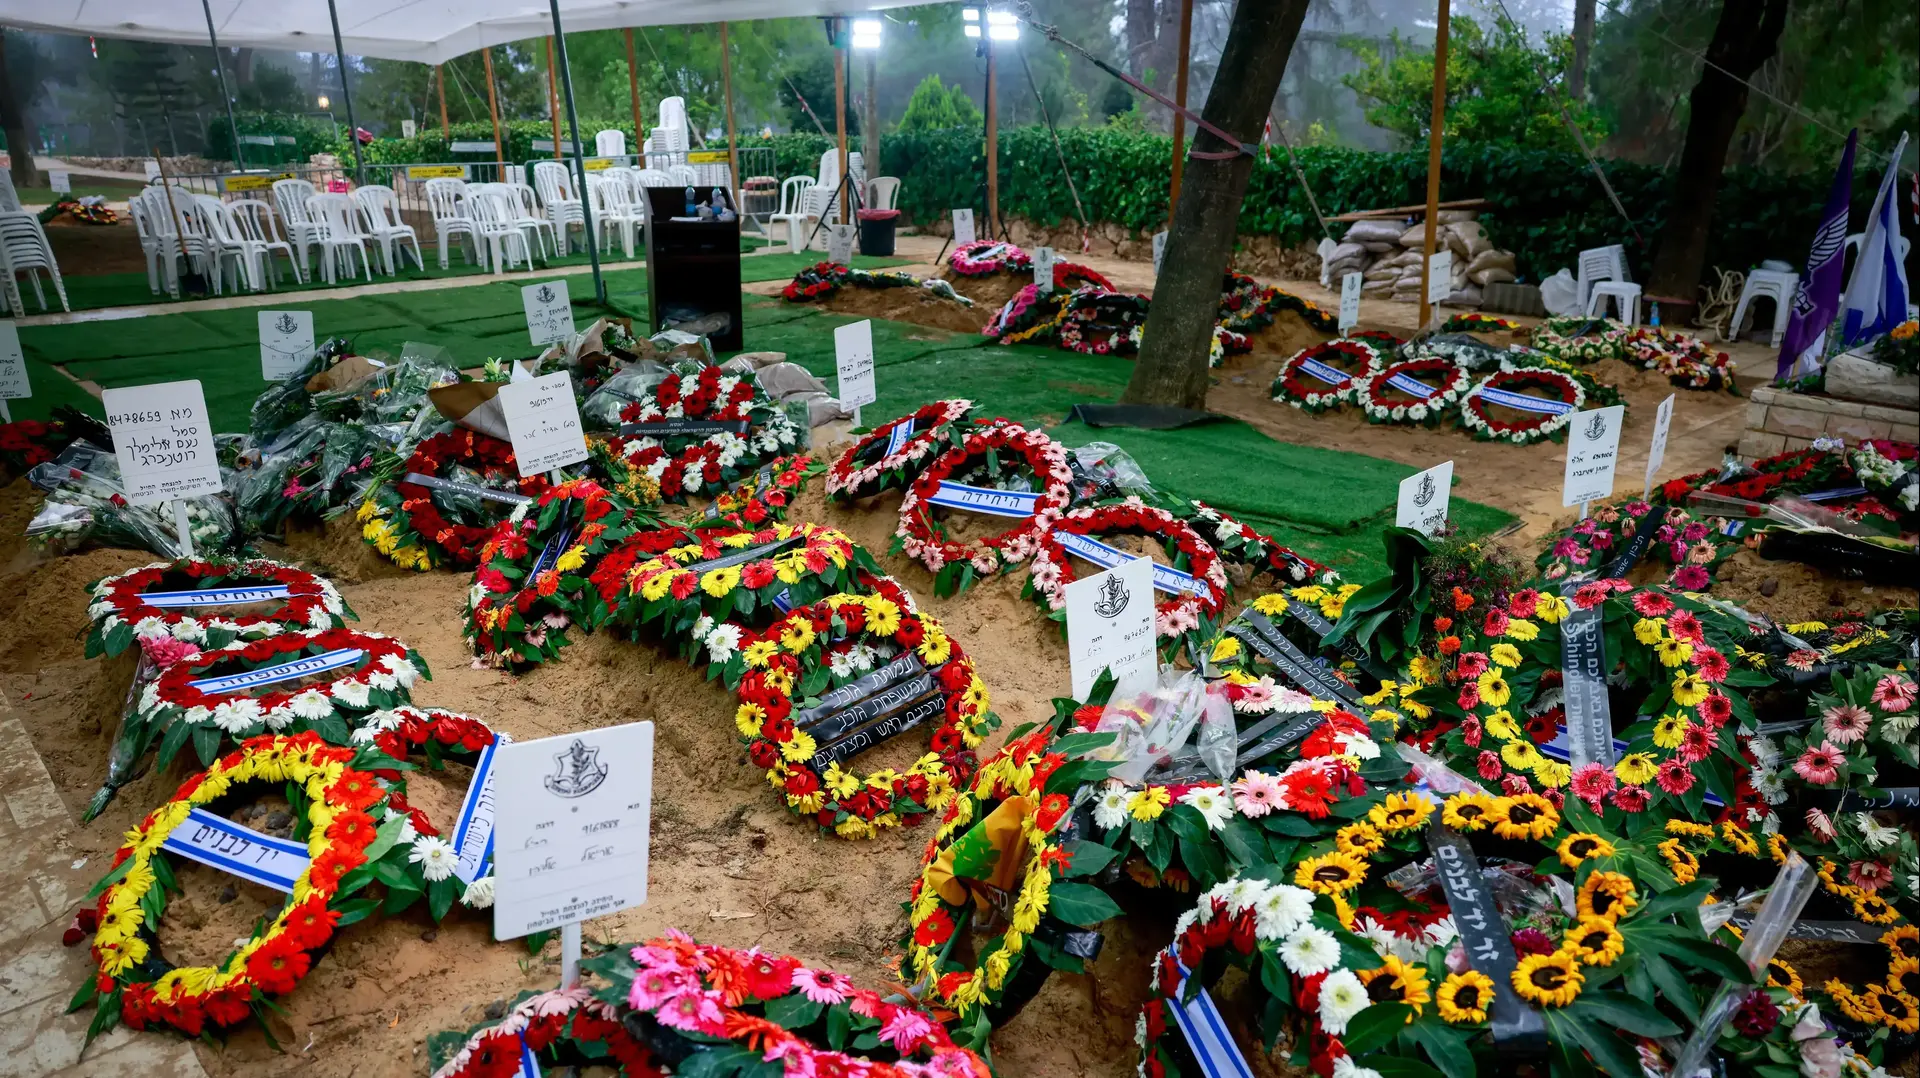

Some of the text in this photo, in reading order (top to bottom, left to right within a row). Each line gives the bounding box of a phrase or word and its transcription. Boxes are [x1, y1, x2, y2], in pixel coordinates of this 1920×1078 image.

[109, 411, 161, 426] 8478659
[171, 425, 197, 437] סמל
[141, 450, 196, 467] רוטנברג
[177, 438, 198, 449] נעם
[961, 490, 1020, 508] היחידה
[191, 589, 274, 603] היחידה
[220, 656, 327, 688] המשפחה
[1265, 627, 1344, 691] ומשפחת גולני
[1566, 622, 1585, 701] Schindler
[829, 656, 914, 709] עמותת גולני
[836, 679, 926, 732] ומשפחת גולני
[815, 697, 946, 768] מרכינים ראש ומצדיעים
[192, 824, 279, 863] יד לבנים
[1437, 845, 1479, 902] לבנים
